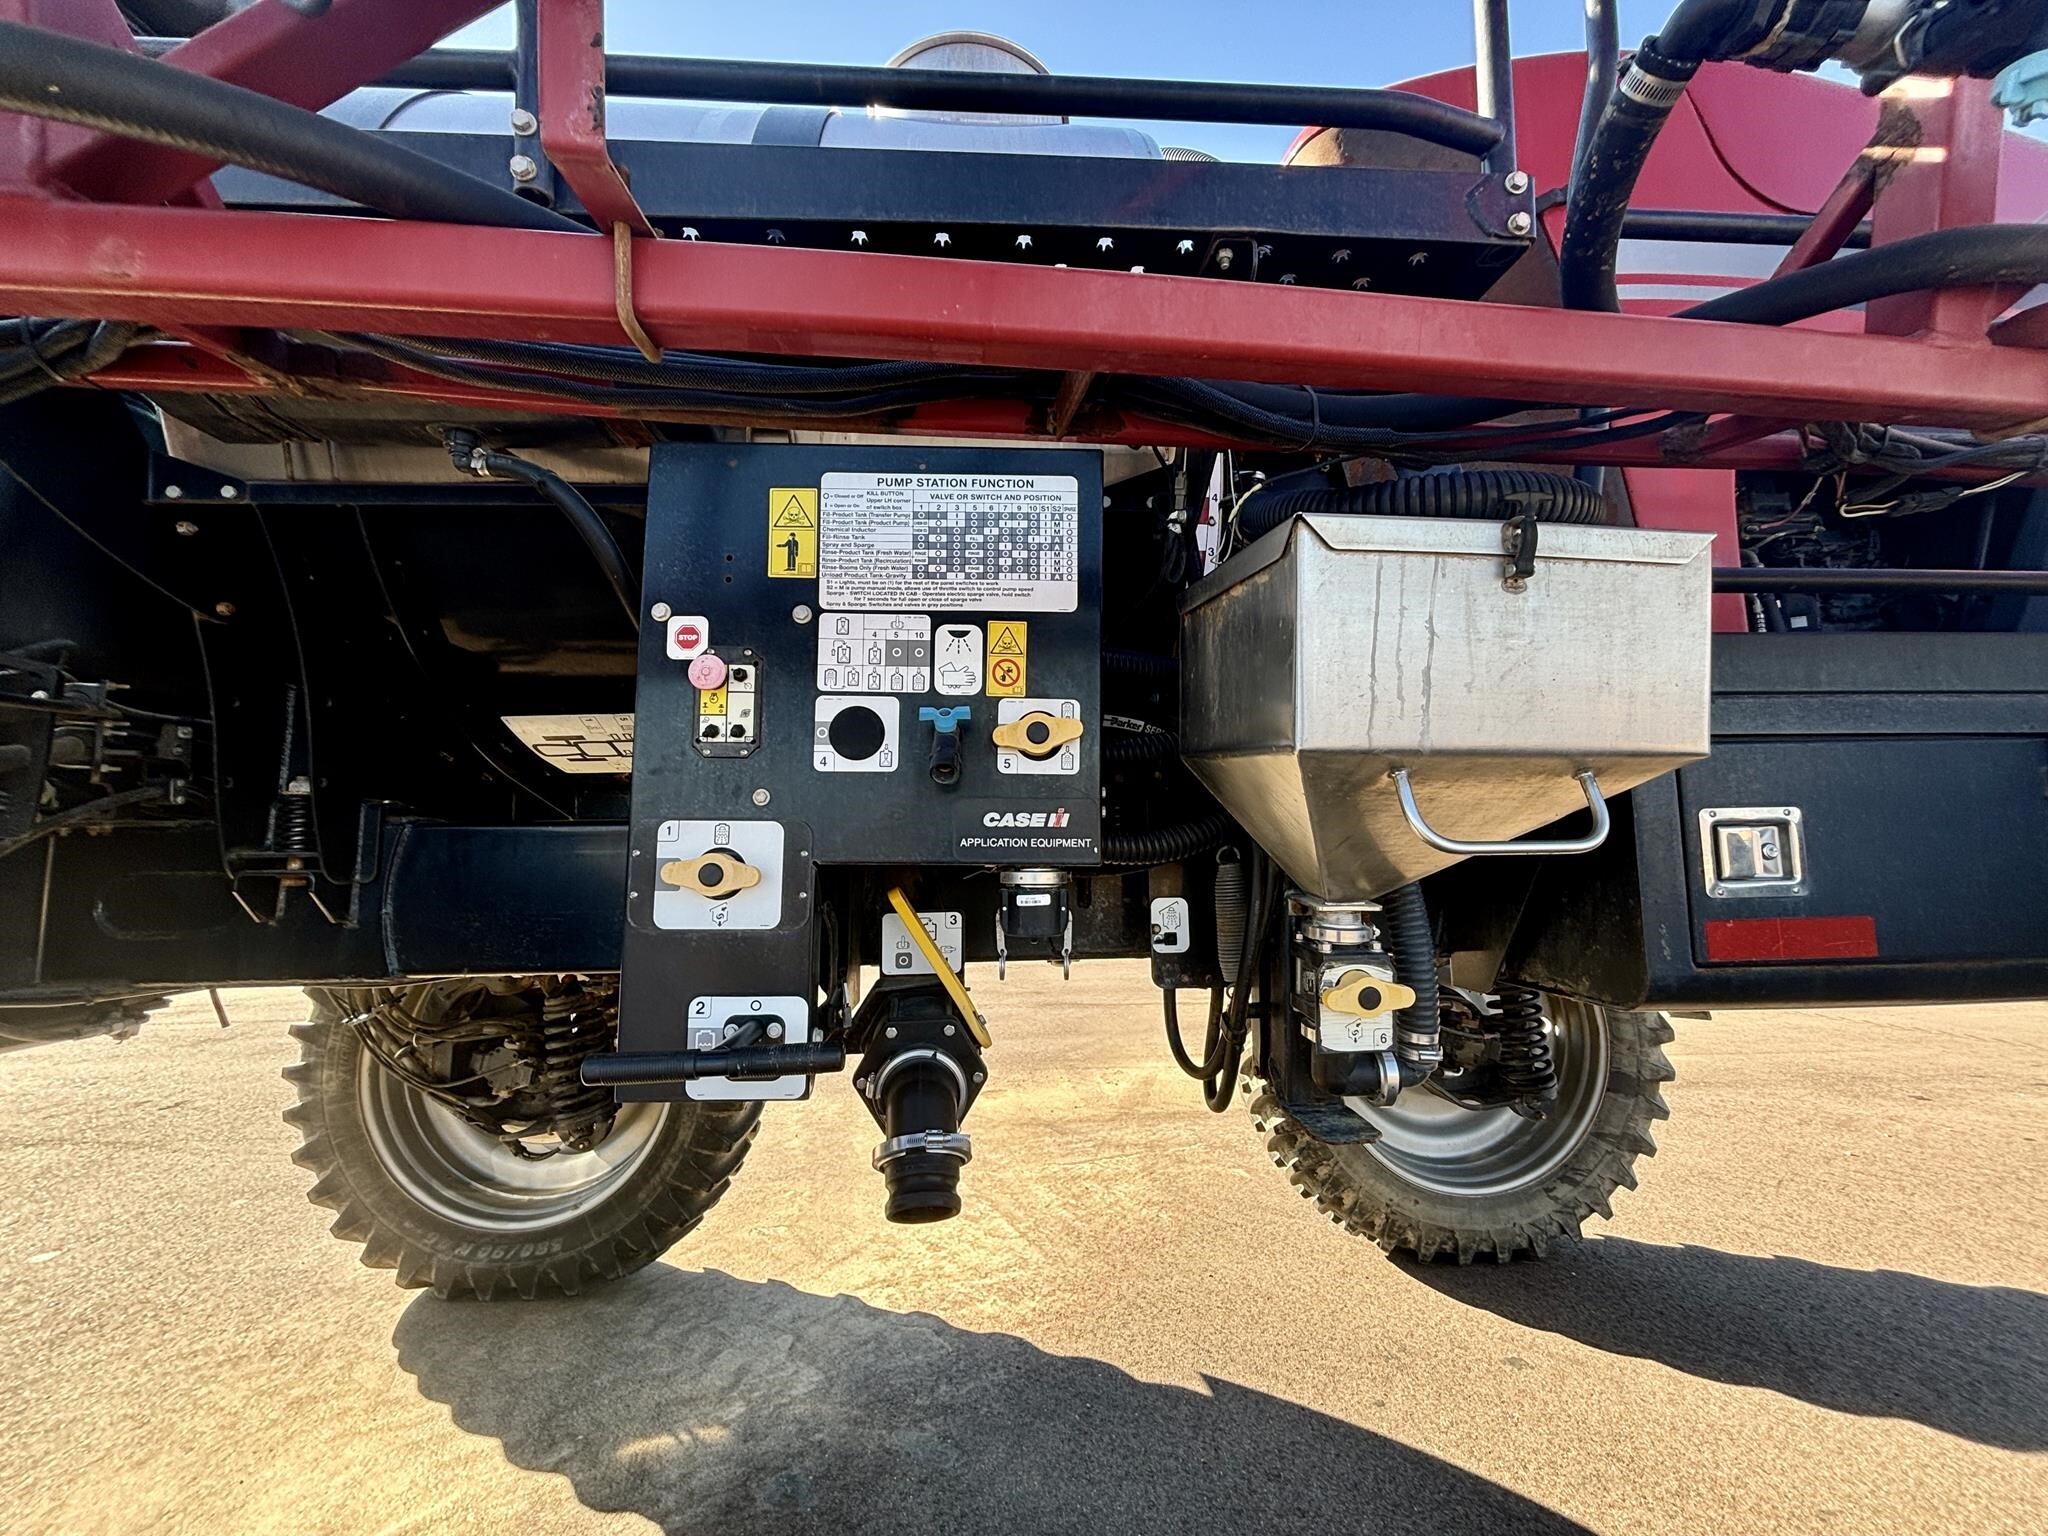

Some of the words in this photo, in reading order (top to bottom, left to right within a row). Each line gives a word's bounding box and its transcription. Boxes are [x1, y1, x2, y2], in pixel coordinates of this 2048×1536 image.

[877, 477, 912, 487] PUMP
[917, 478, 967, 488] STATION
[972, 479, 1034, 488] FUNCTION
[678, 634, 699, 642] STOP
[894, 631, 899, 639] 5
[914, 631, 924, 639] 10
[1112, 717, 1142, 731] Parker
[819, 756, 828, 767] 4
[1003, 758, 1012, 769] 5
[983, 812, 1047, 828] CASE
[666, 825, 671, 836] 1
[959, 838, 1027, 848] APPLICATION
[1031, 838, 1092, 849] EQUIPMENT
[949, 914, 957, 925] 3
[695, 1001, 706, 1015] 2
[1379, 1033, 1388, 1044] 6
